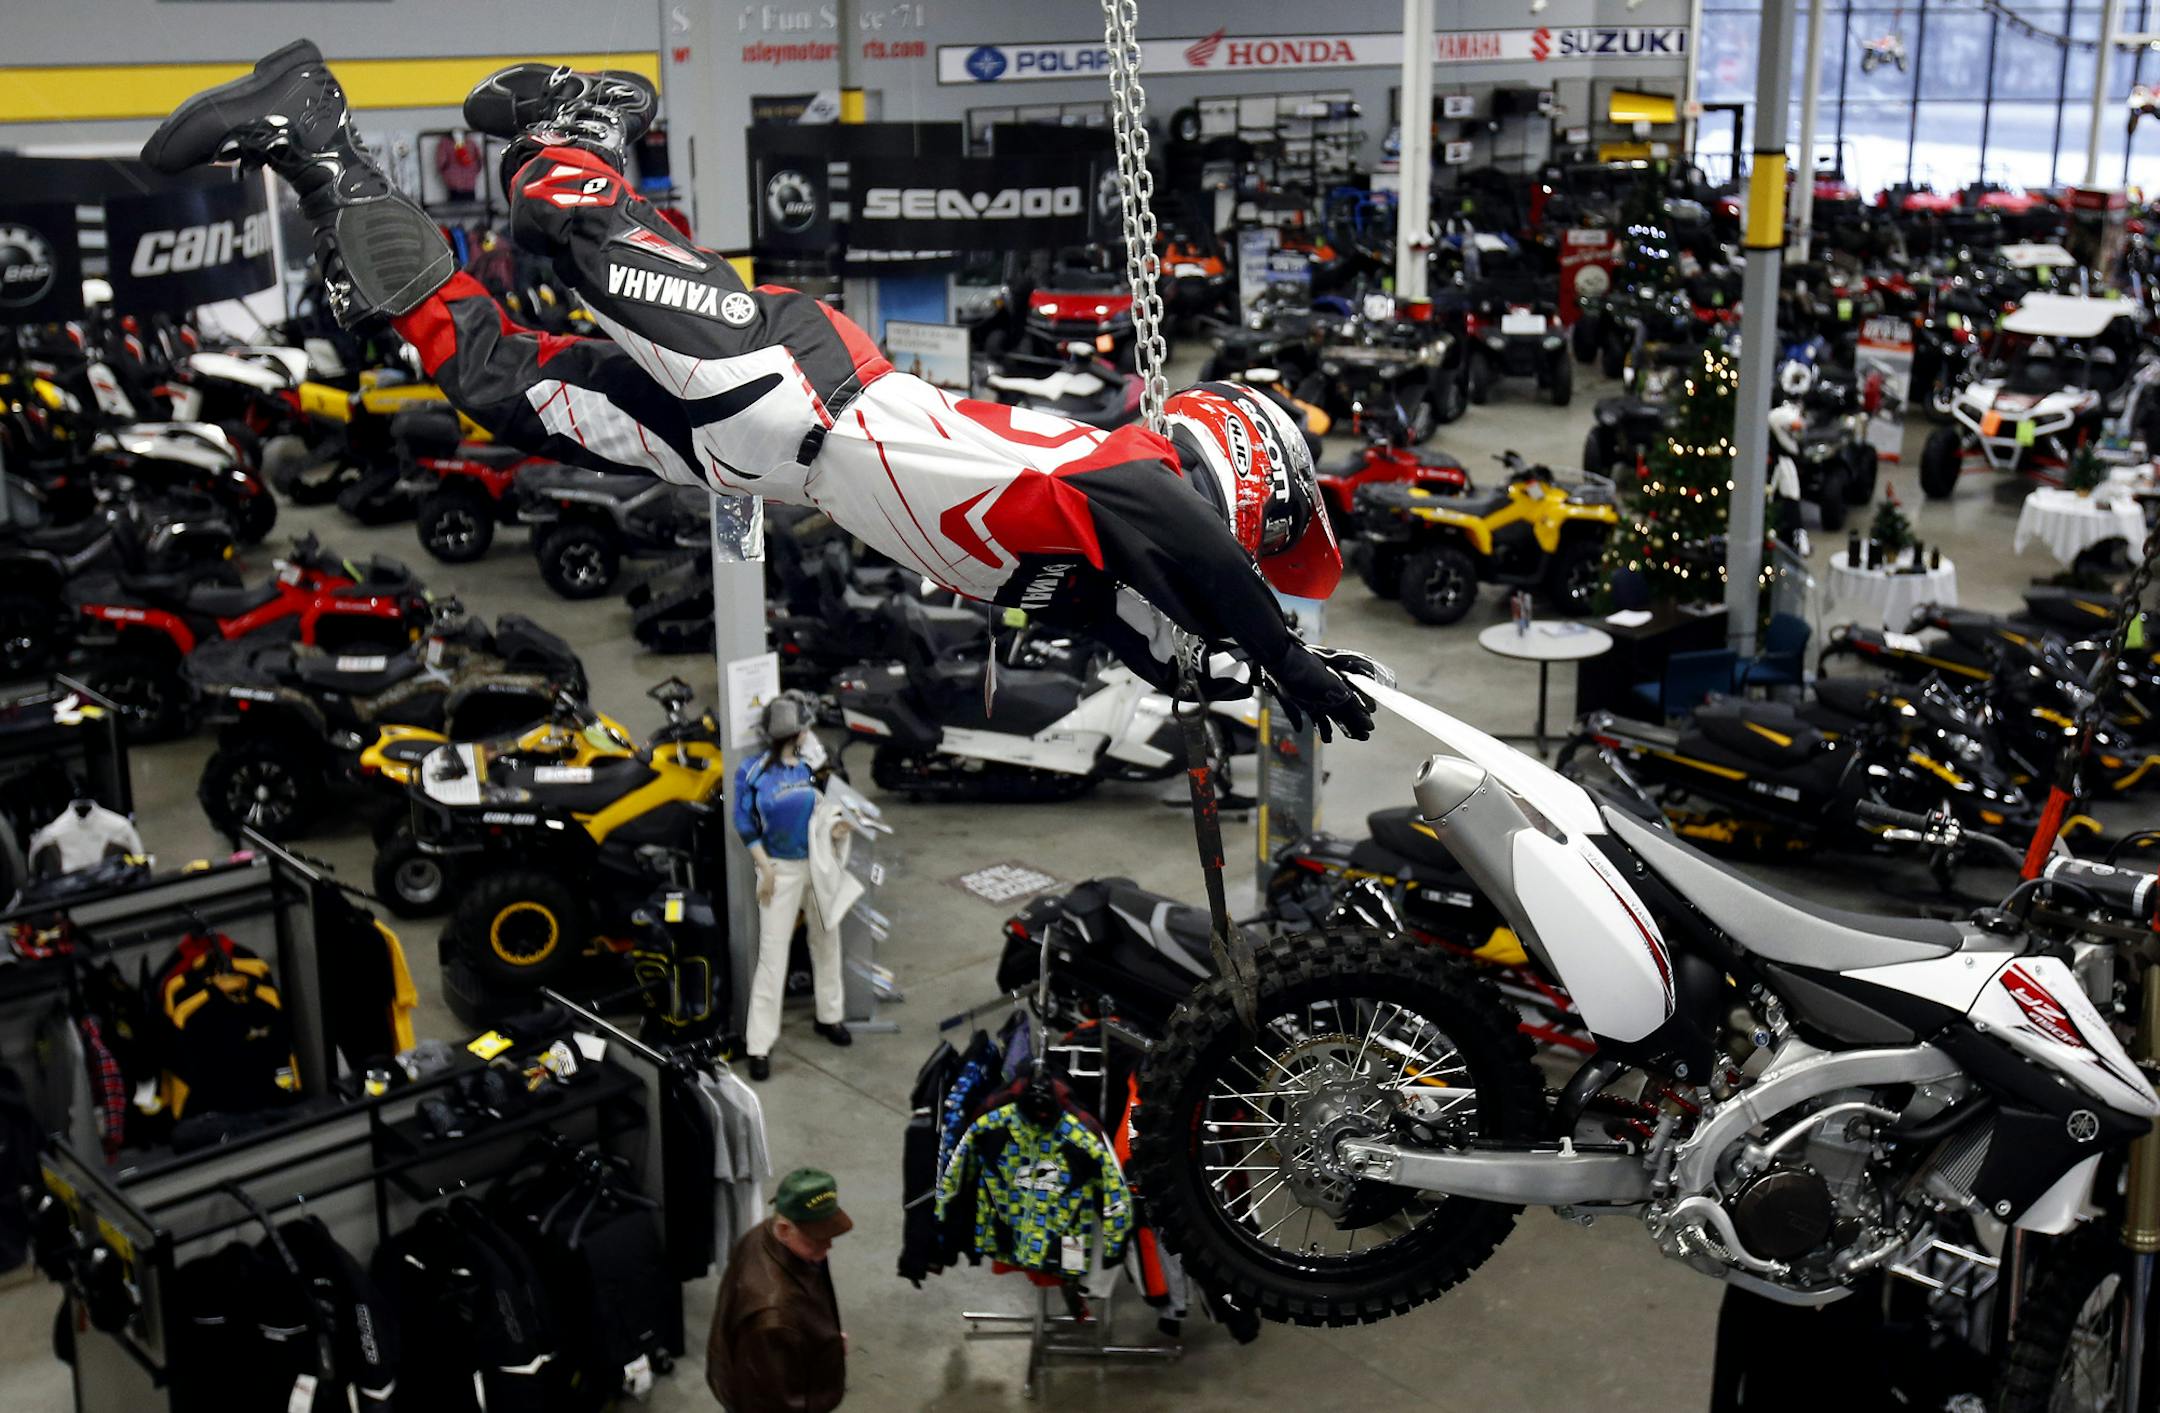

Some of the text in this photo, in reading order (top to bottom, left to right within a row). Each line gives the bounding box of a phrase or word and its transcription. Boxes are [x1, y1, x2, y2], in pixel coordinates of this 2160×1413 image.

[1226, 39, 1356, 66] HONDA
[1438, 32, 1502, 60] YAMAHA
[1559, 28, 1685, 55] SUZUKI
[1017, 50, 1136, 72] POLAR
[608, 263, 718, 317] YAMAHA
